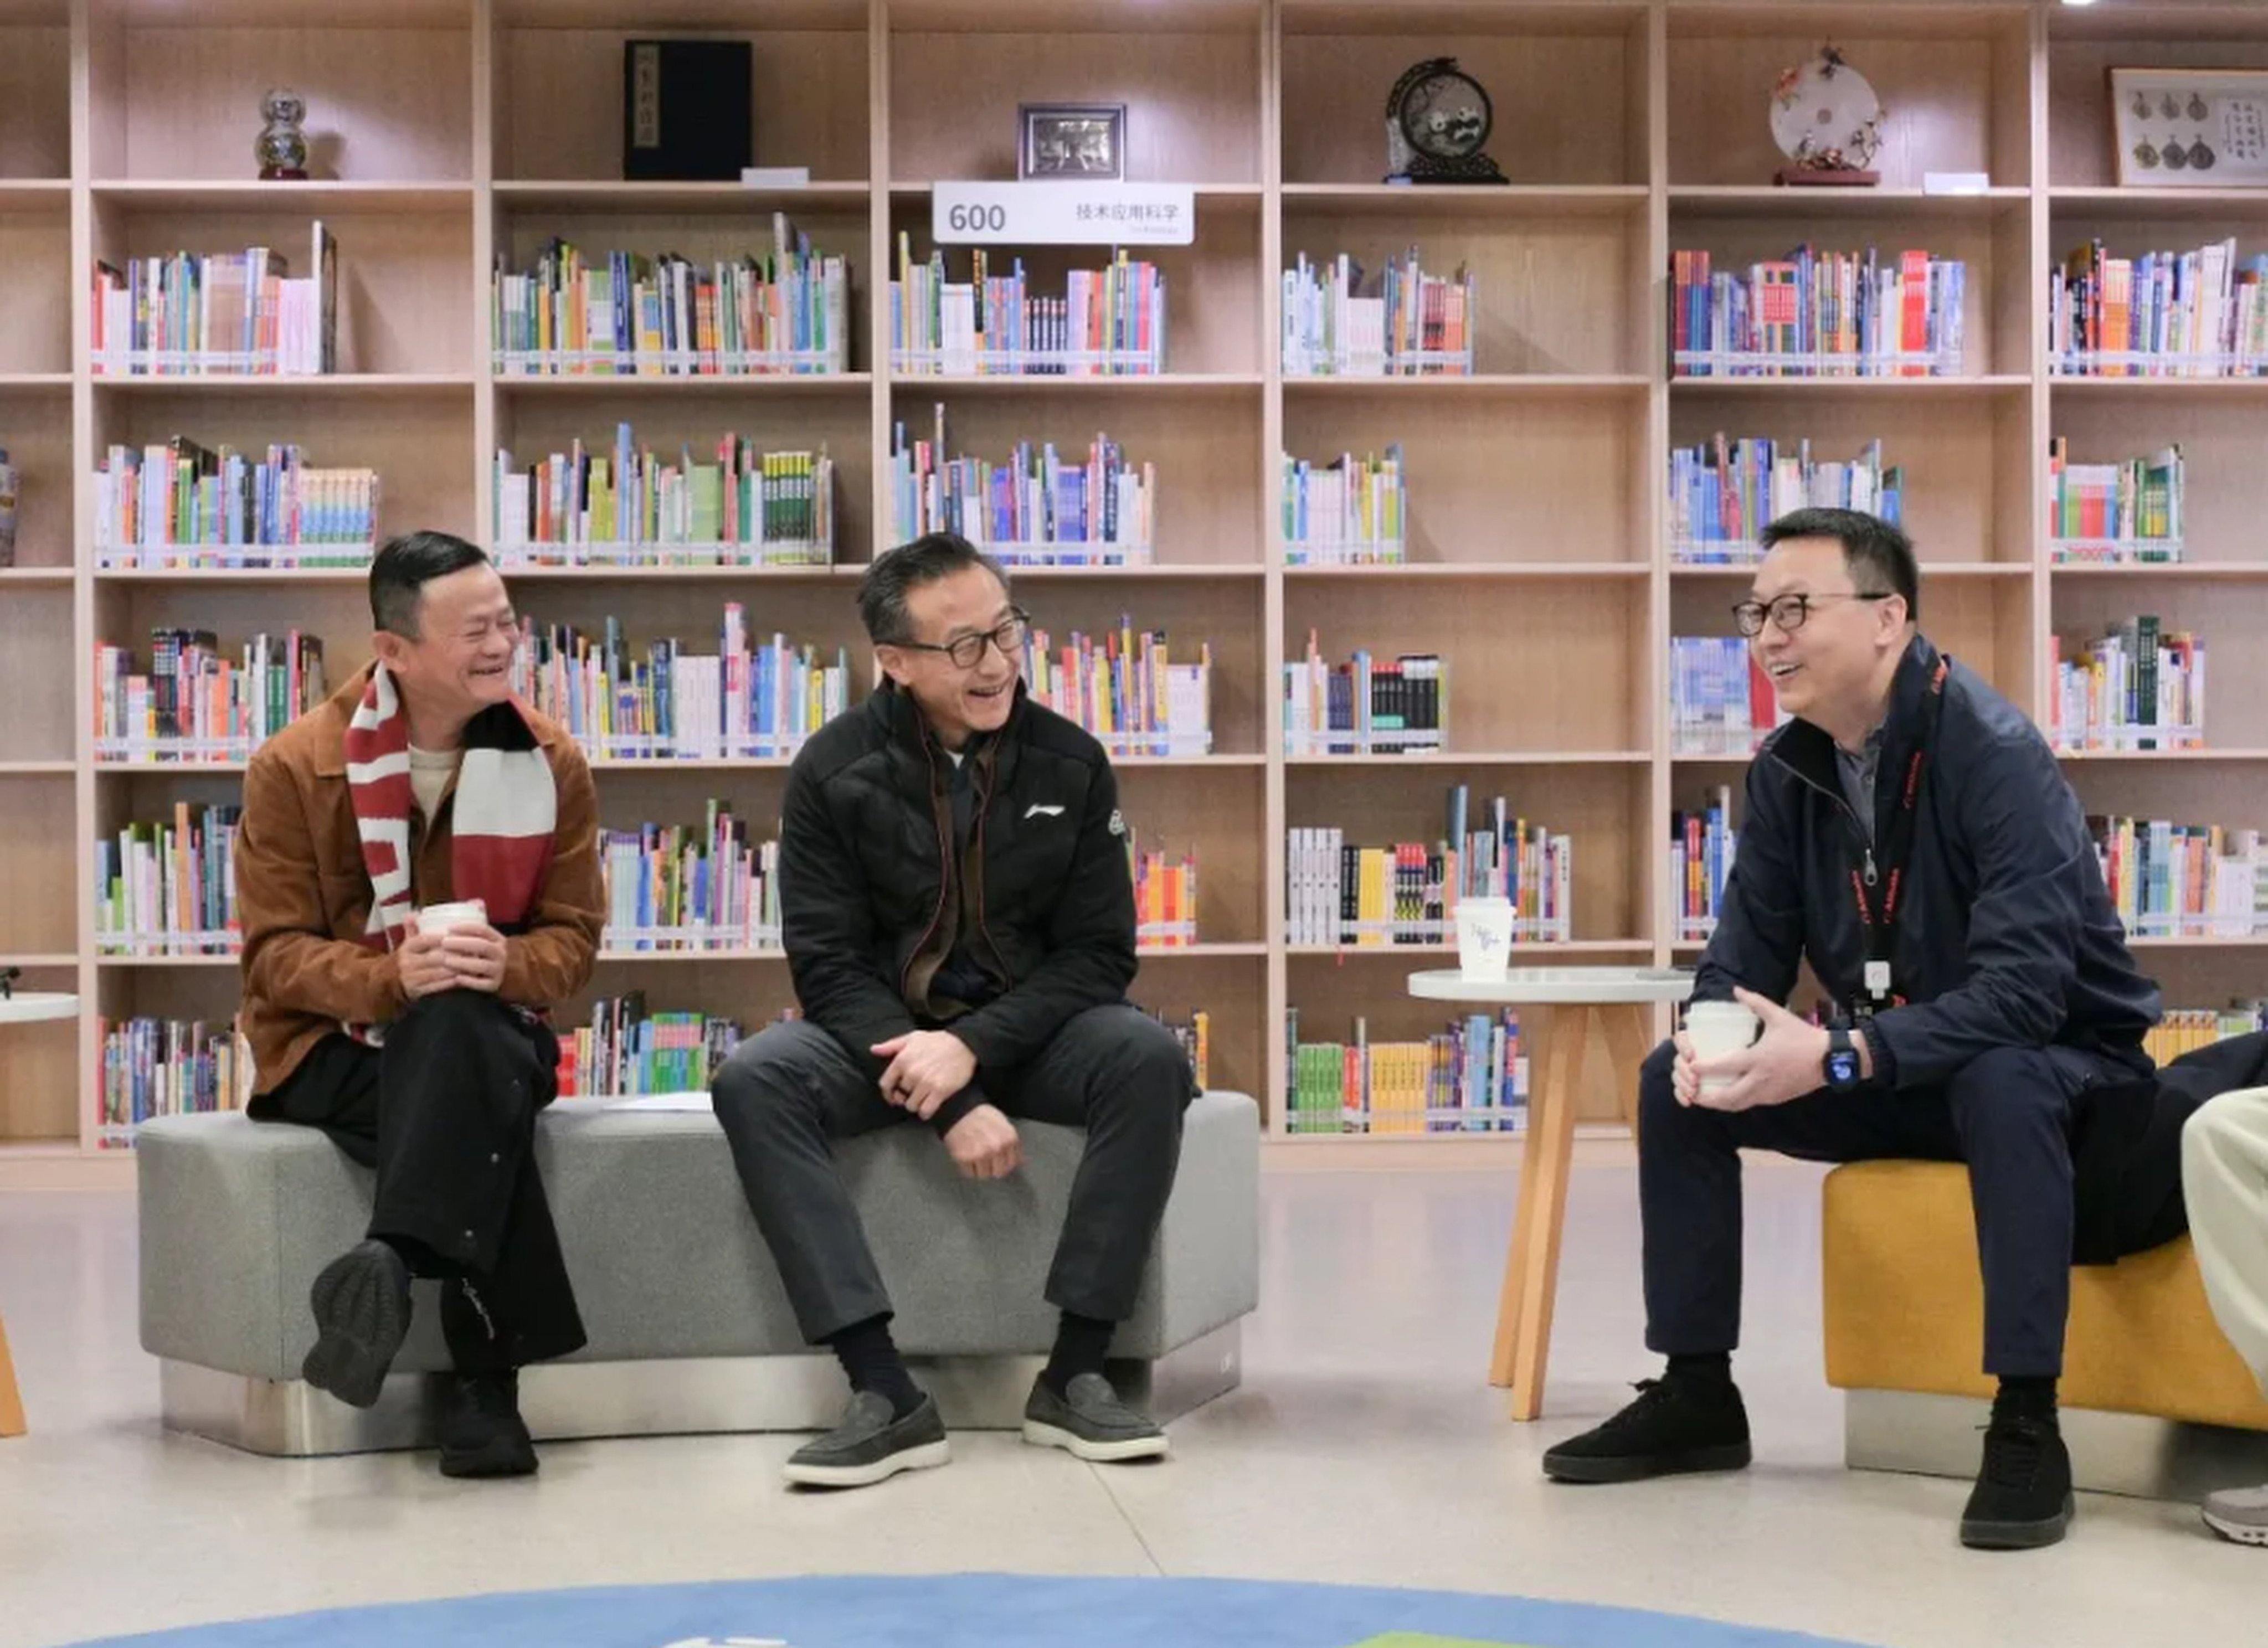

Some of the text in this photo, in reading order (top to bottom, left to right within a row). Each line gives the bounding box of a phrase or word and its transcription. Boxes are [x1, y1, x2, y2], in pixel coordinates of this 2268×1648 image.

[950, 204, 1005, 231] 600
[1077, 201, 1180, 222] 技术应用科学
